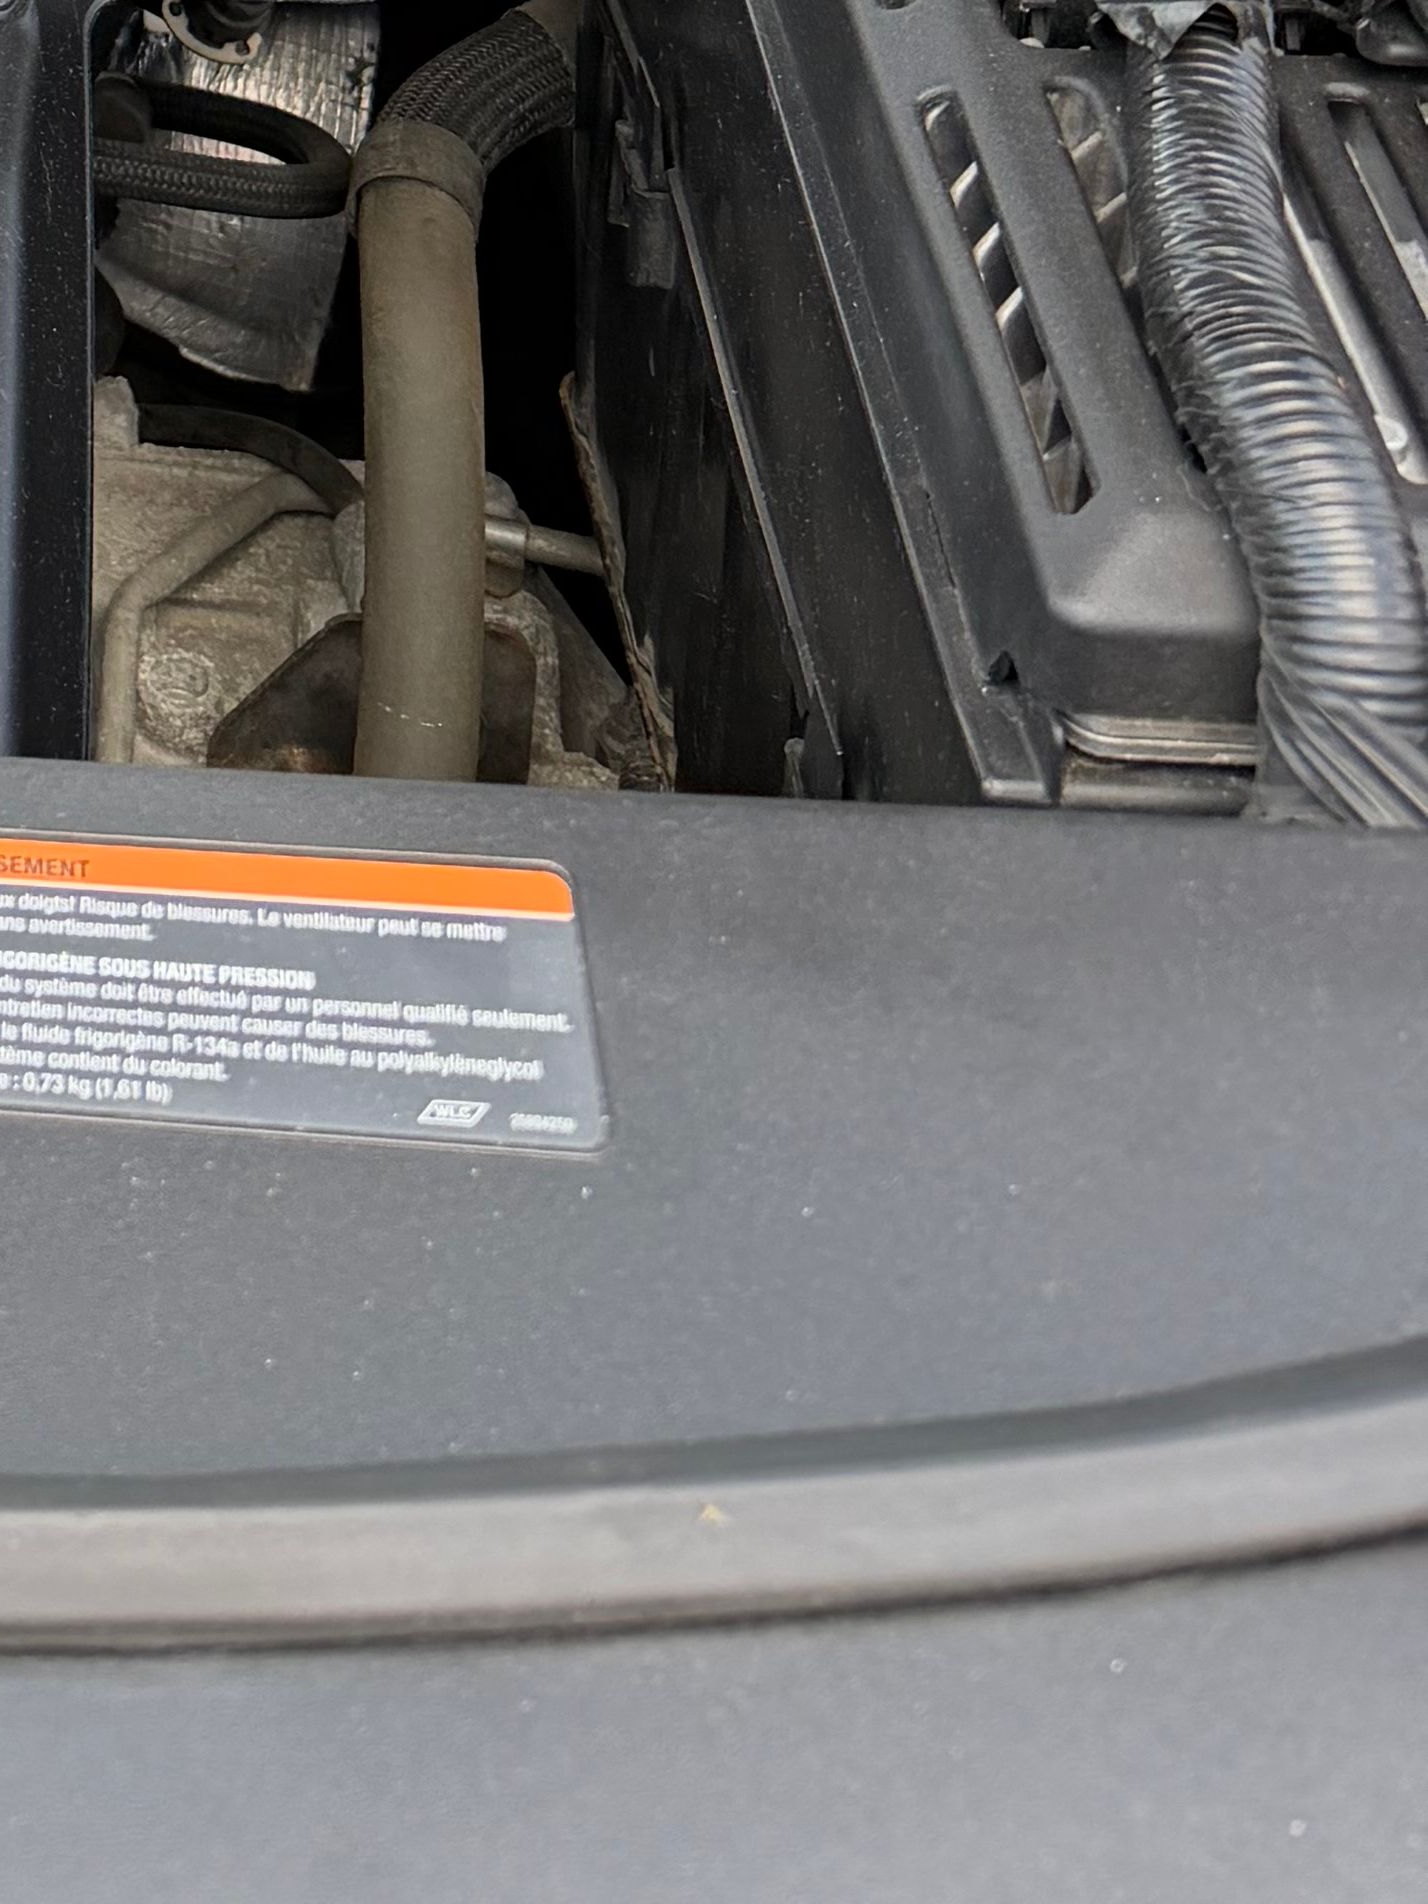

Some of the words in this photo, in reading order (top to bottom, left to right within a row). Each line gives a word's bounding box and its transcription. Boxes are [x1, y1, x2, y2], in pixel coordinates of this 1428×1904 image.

[80, 896, 138, 917] Risque
[142, 902, 165, 919] de
[257, 908, 281, 927] Le
[283, 912, 376, 932] ventilateur
[378, 919, 420, 936] peut
[422, 922, 443, 937] se
[99, 958, 151, 978] SOUS
[154, 961, 217, 983] HAUTE
[219, 966, 316, 989] PRESSION
[24, 978, 97, 997] système
[101, 982, 135, 1000] doit
[138, 983, 173, 1003] être
[177, 987, 247, 1008] effectué
[251, 995, 283, 1011] par
[285, 997, 309, 1013] un
[312, 999, 402, 1019] personnel
[403, 1004, 468, 1025] qualifié
[67, 1005, 165, 1026] incorrectes
[168, 1012, 239, 1031] peuvent
[242, 1018, 303, 1036] causer
[305, 1020, 339, 1040] des
[1, 1021, 18, 1041] le
[21, 1023, 72, 1044] fluide
[74, 1029, 170, 1052] frigorigène
[173, 1034, 239, 1057] R-134a
[242, 1040, 263, 1059] et
[265, 1042, 288, 1061] de
[350, 1050, 374, 1068] au
[47, 1052, 120, 1072] contient
[122, 1055, 147, 1075] du
[68, 1076, 93, 1100] kg
